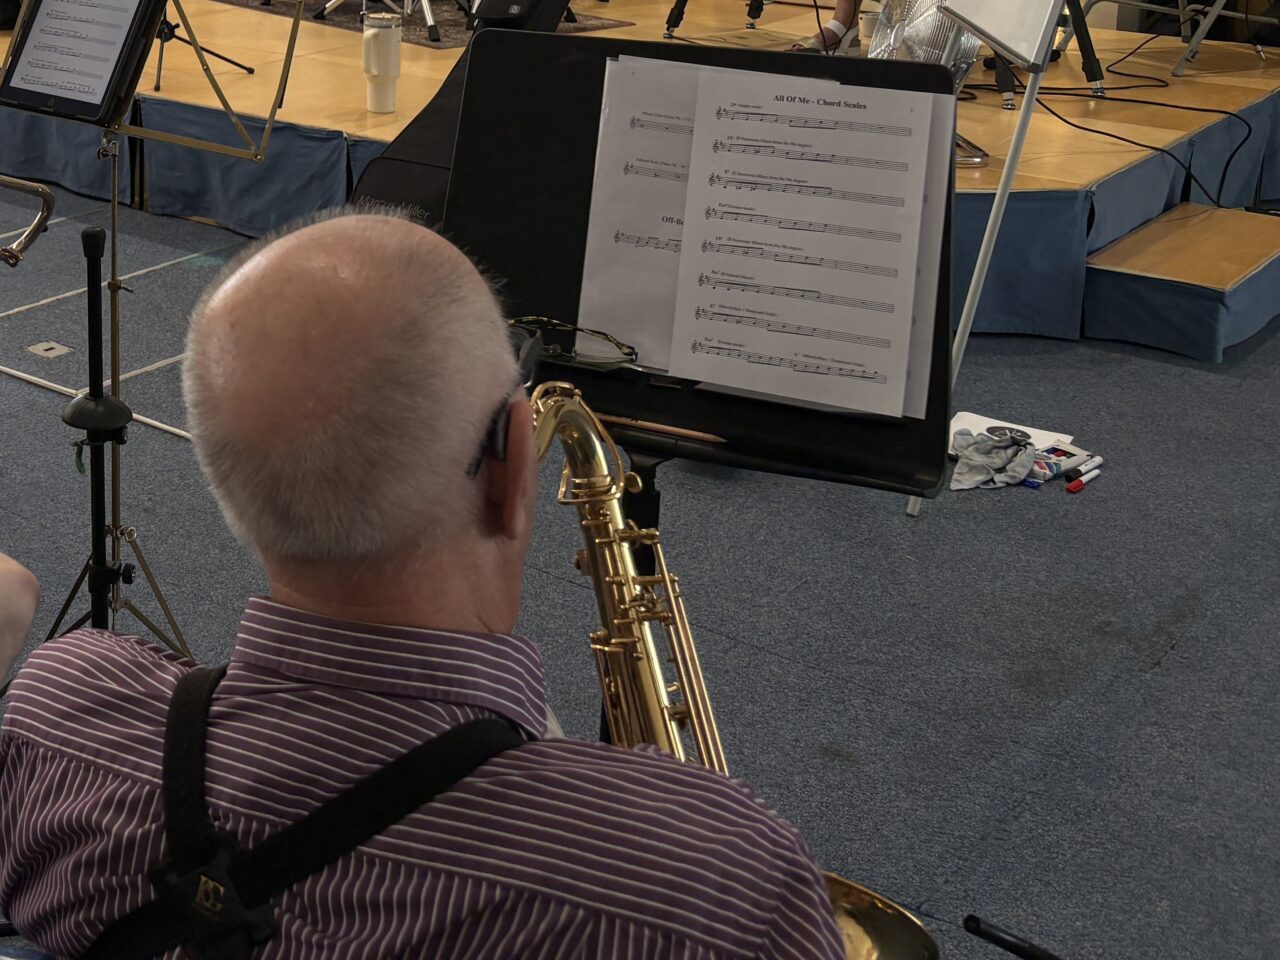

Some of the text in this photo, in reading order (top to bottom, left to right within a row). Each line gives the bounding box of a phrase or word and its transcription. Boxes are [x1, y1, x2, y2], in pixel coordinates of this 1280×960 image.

[773, 94, 785, 102] All
[786, 95, 797, 103] Of
[797, 96, 810, 105] Me
[816, 98, 841, 108] Chord
[843, 101, 868, 110] Scales
